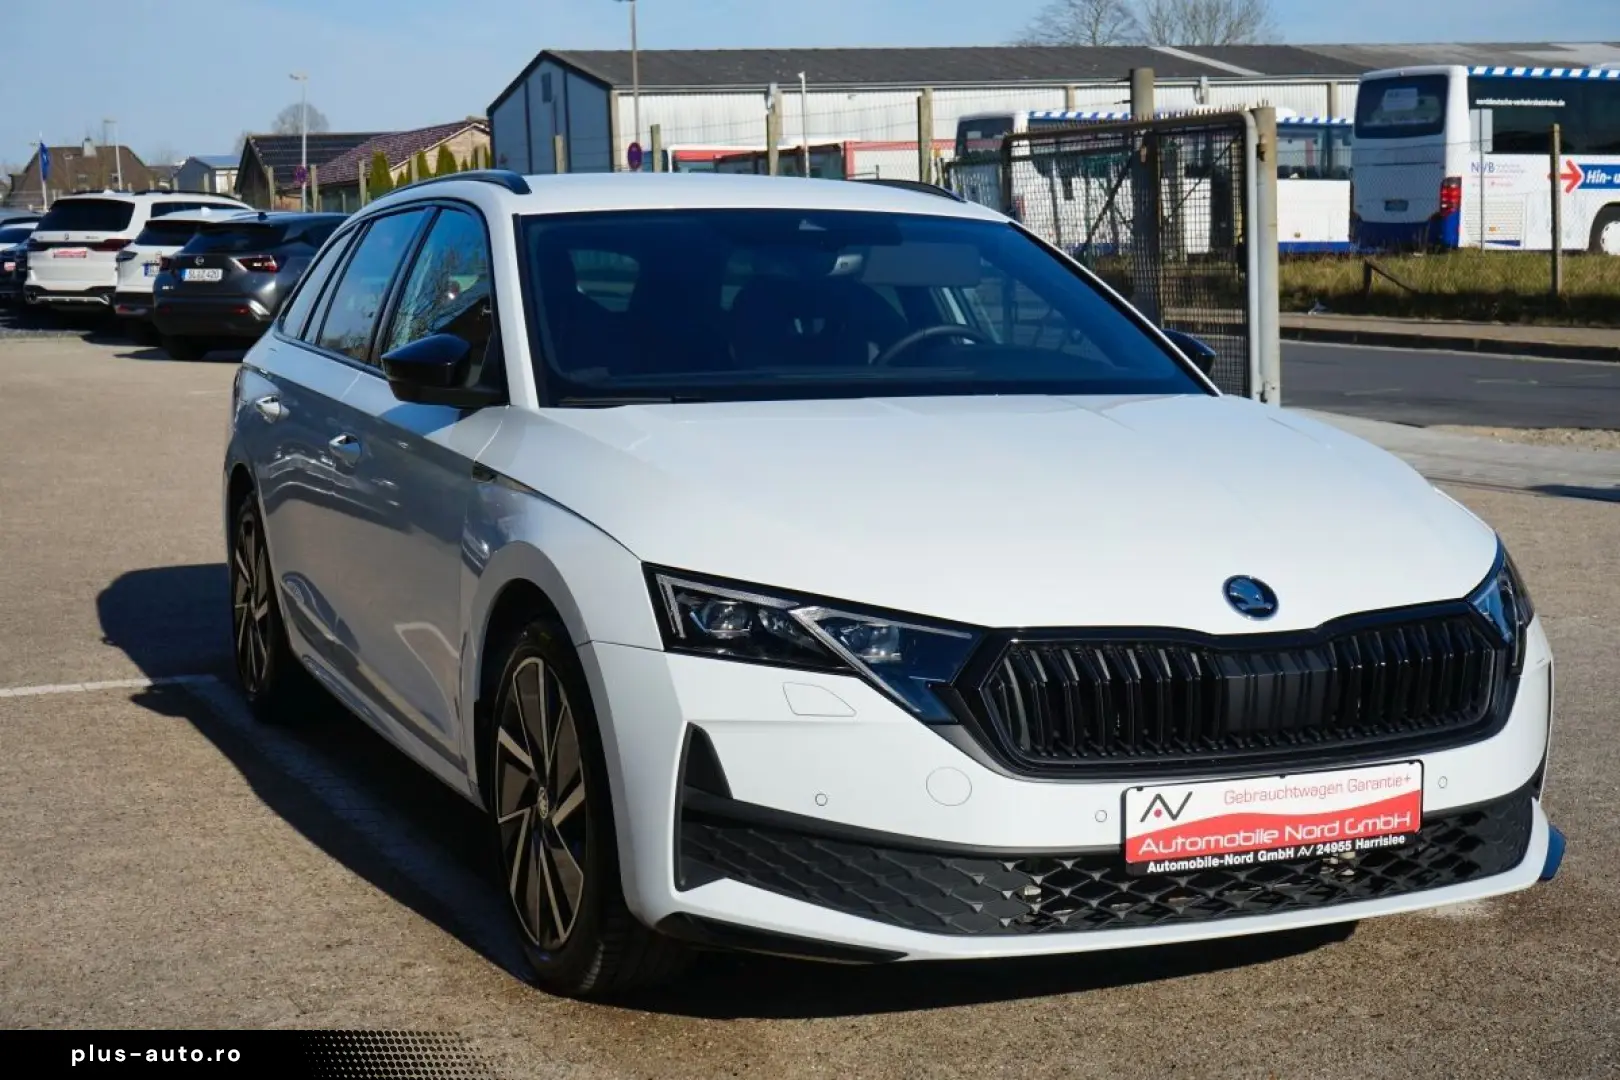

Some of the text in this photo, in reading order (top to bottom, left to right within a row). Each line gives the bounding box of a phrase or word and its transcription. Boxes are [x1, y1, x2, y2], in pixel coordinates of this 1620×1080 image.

[1585, 169, 1613, 185] Hin-
[1223, 774, 1412, 805] Gebrauchtwagen Garantie+
[1138, 811, 1412, 855] Automobile Nord GmbH
[1146, 851, 1254, 874] Automobile-Nord
[1257, 847, 1295, 863] GmbH
[1315, 840, 1352, 856] 24955
[1355, 834, 1406, 850] Harrislee
